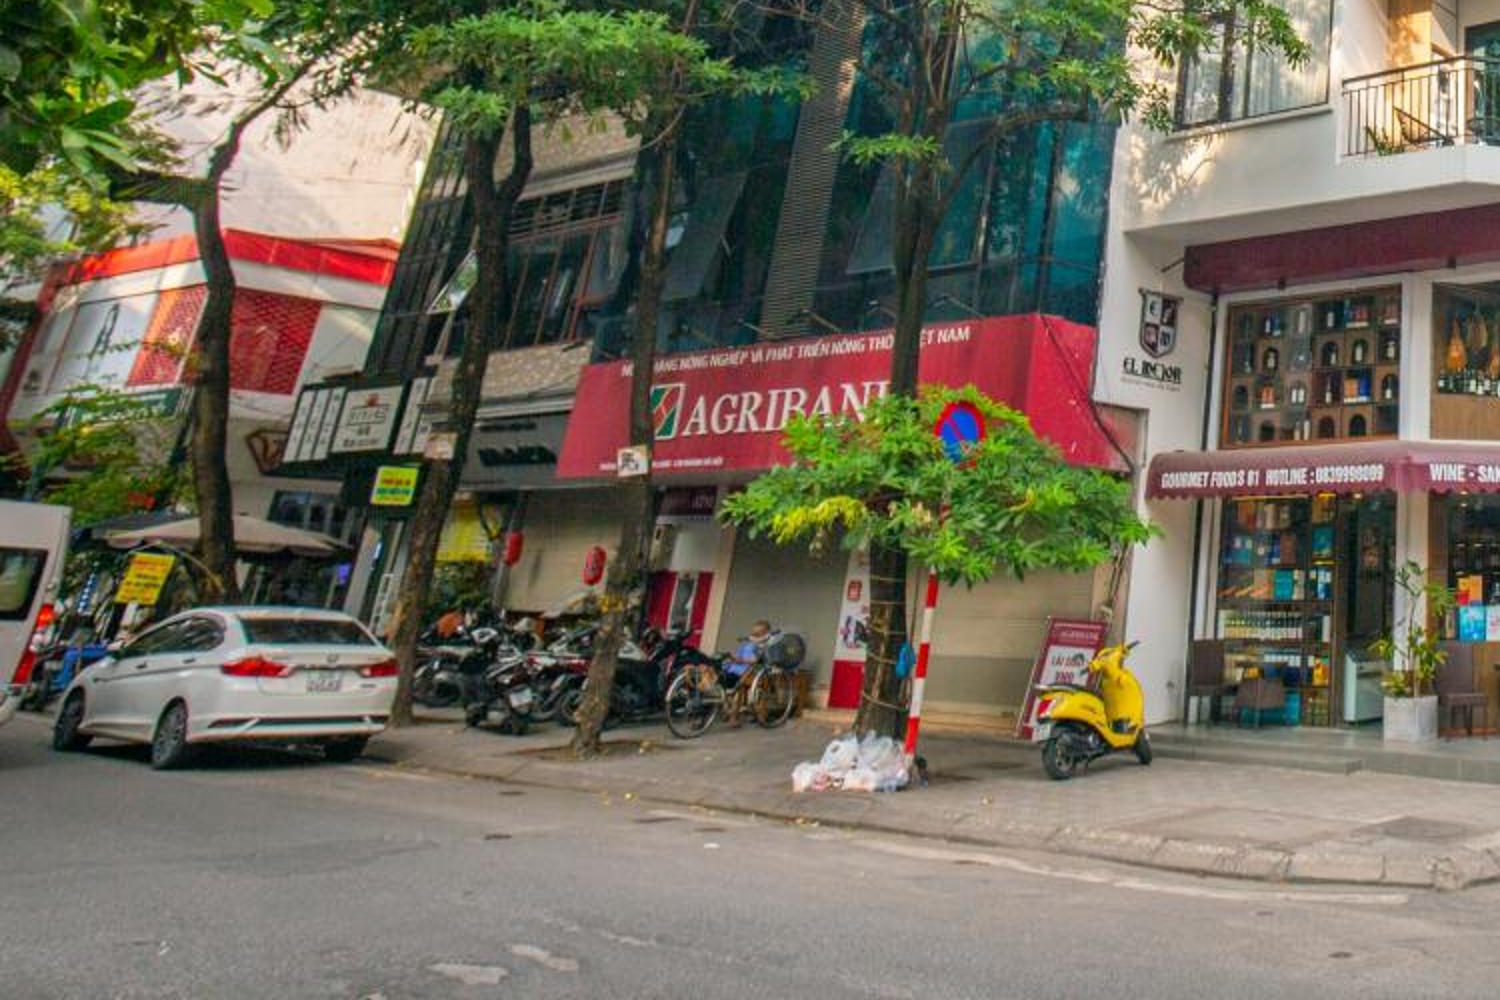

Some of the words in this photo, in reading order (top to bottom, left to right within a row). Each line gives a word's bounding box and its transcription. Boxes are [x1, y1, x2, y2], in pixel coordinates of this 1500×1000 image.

[938, 326, 971, 345] NAM
[1161, 472, 1209, 488] GOURMET
[1209, 470, 1245, 488] FOODS
[1429, 463, 1466, 482] WINE
